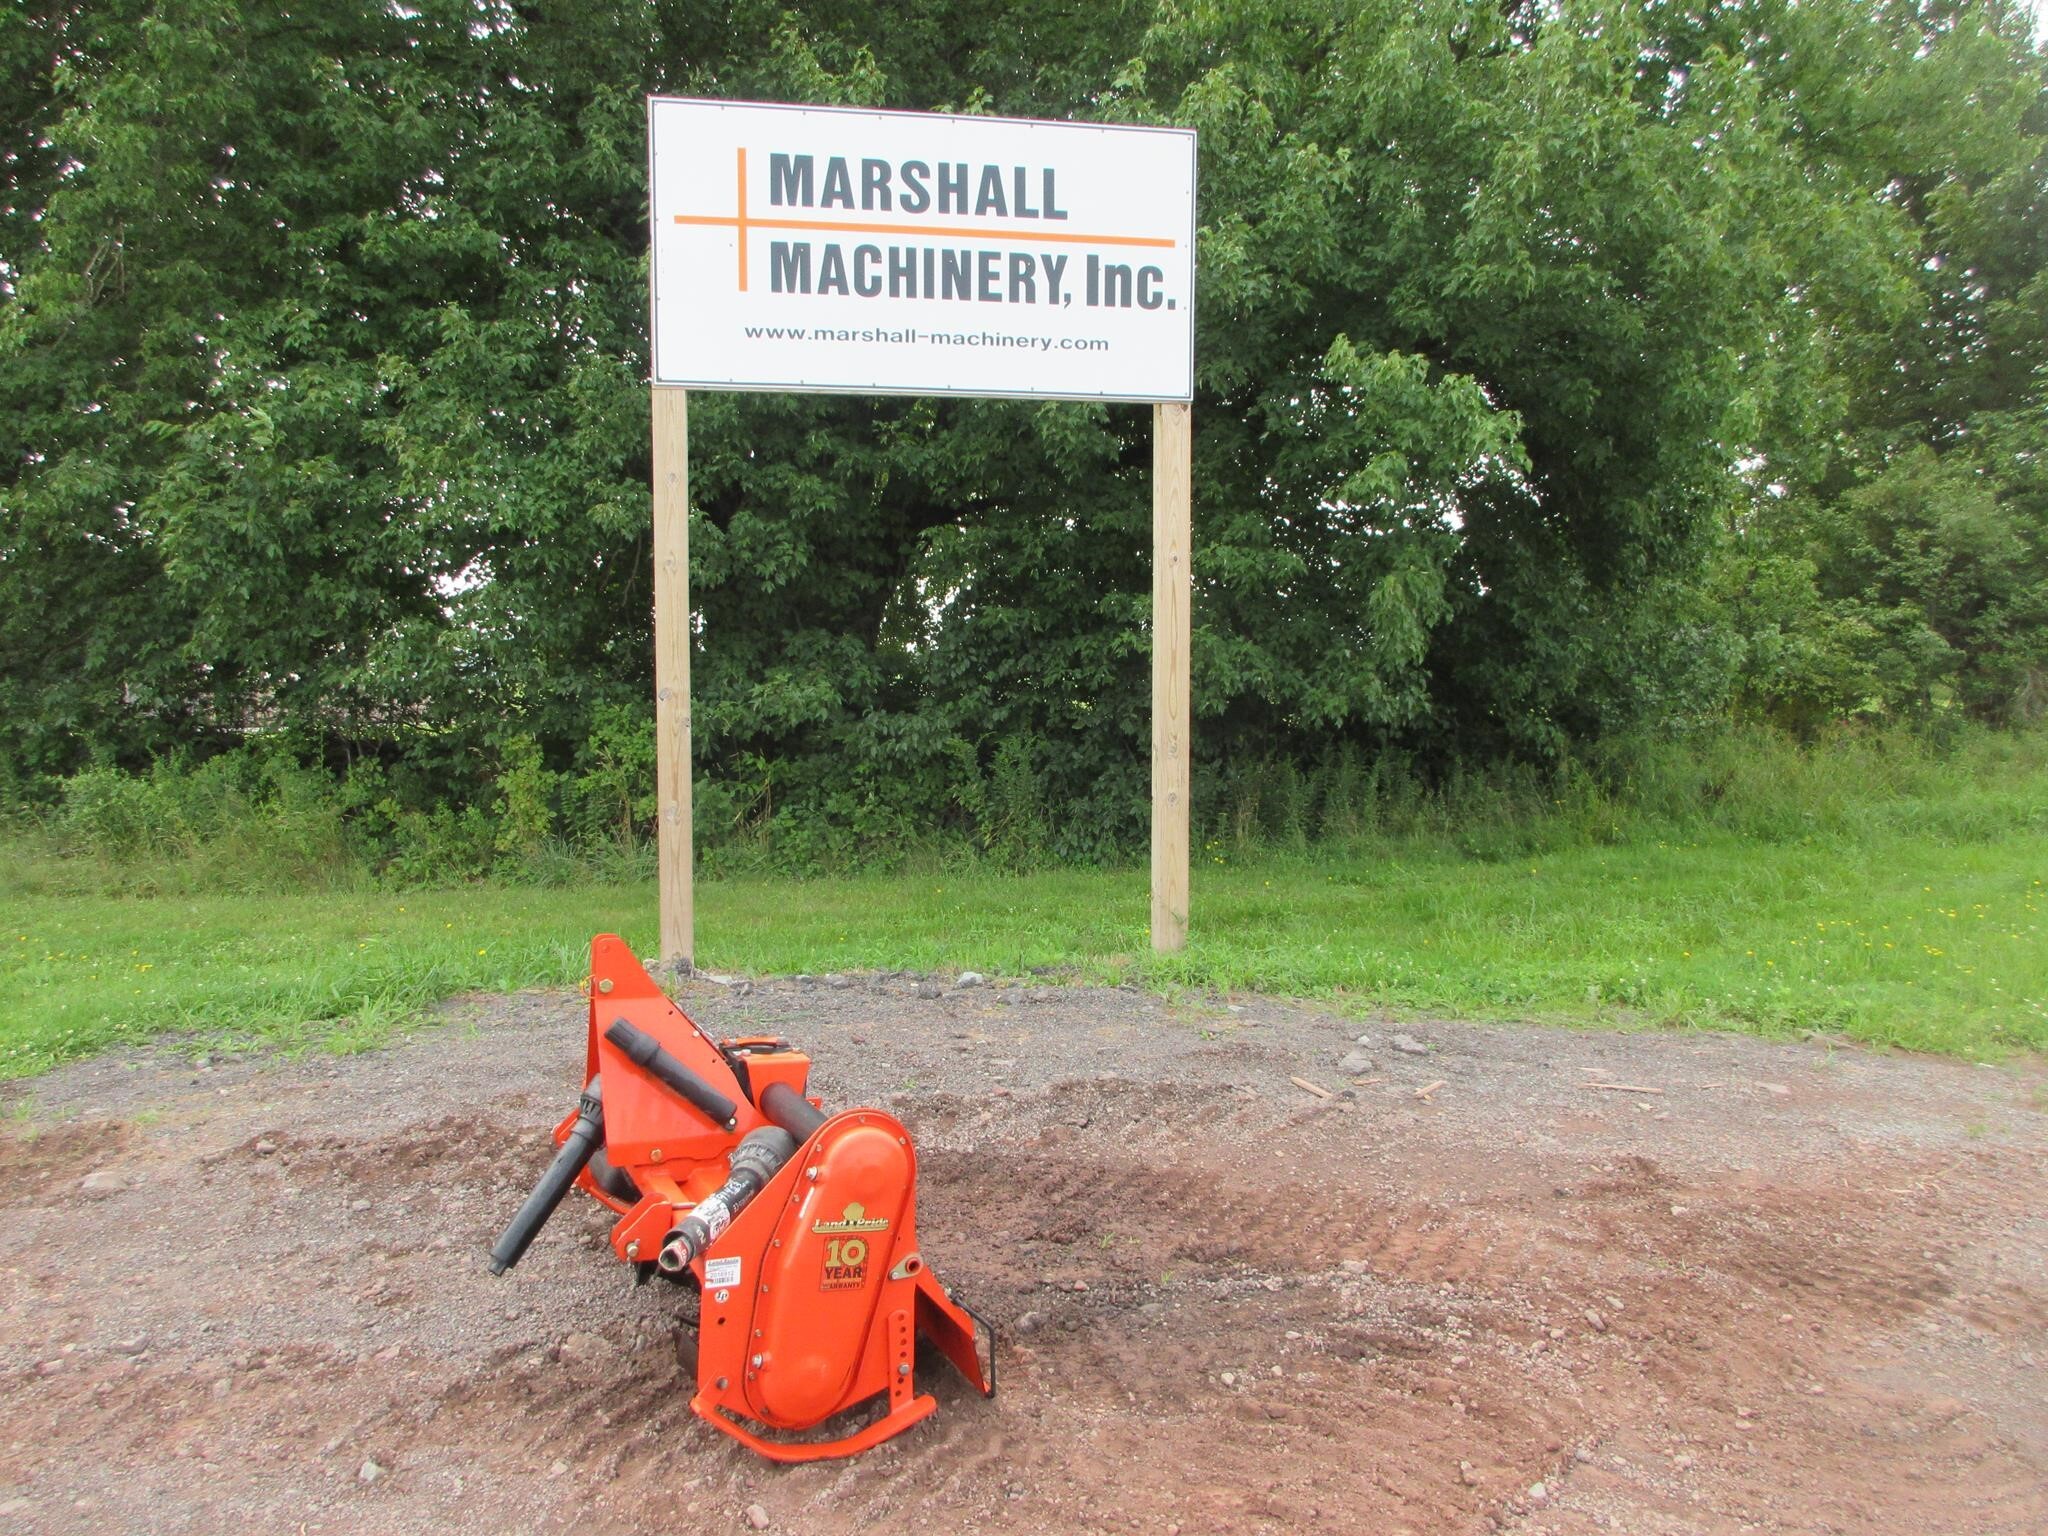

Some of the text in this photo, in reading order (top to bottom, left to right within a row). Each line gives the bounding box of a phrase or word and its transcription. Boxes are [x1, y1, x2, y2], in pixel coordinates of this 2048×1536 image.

[770, 152, 1069, 220] MARSHALL
[770, 240, 1177, 310] MACHINERY, Inc.
[744, 325, 1110, 352] www.marshall-machinery.com
[825, 1239, 866, 1267] 10
[825, 1266, 863, 1280] YEAR
